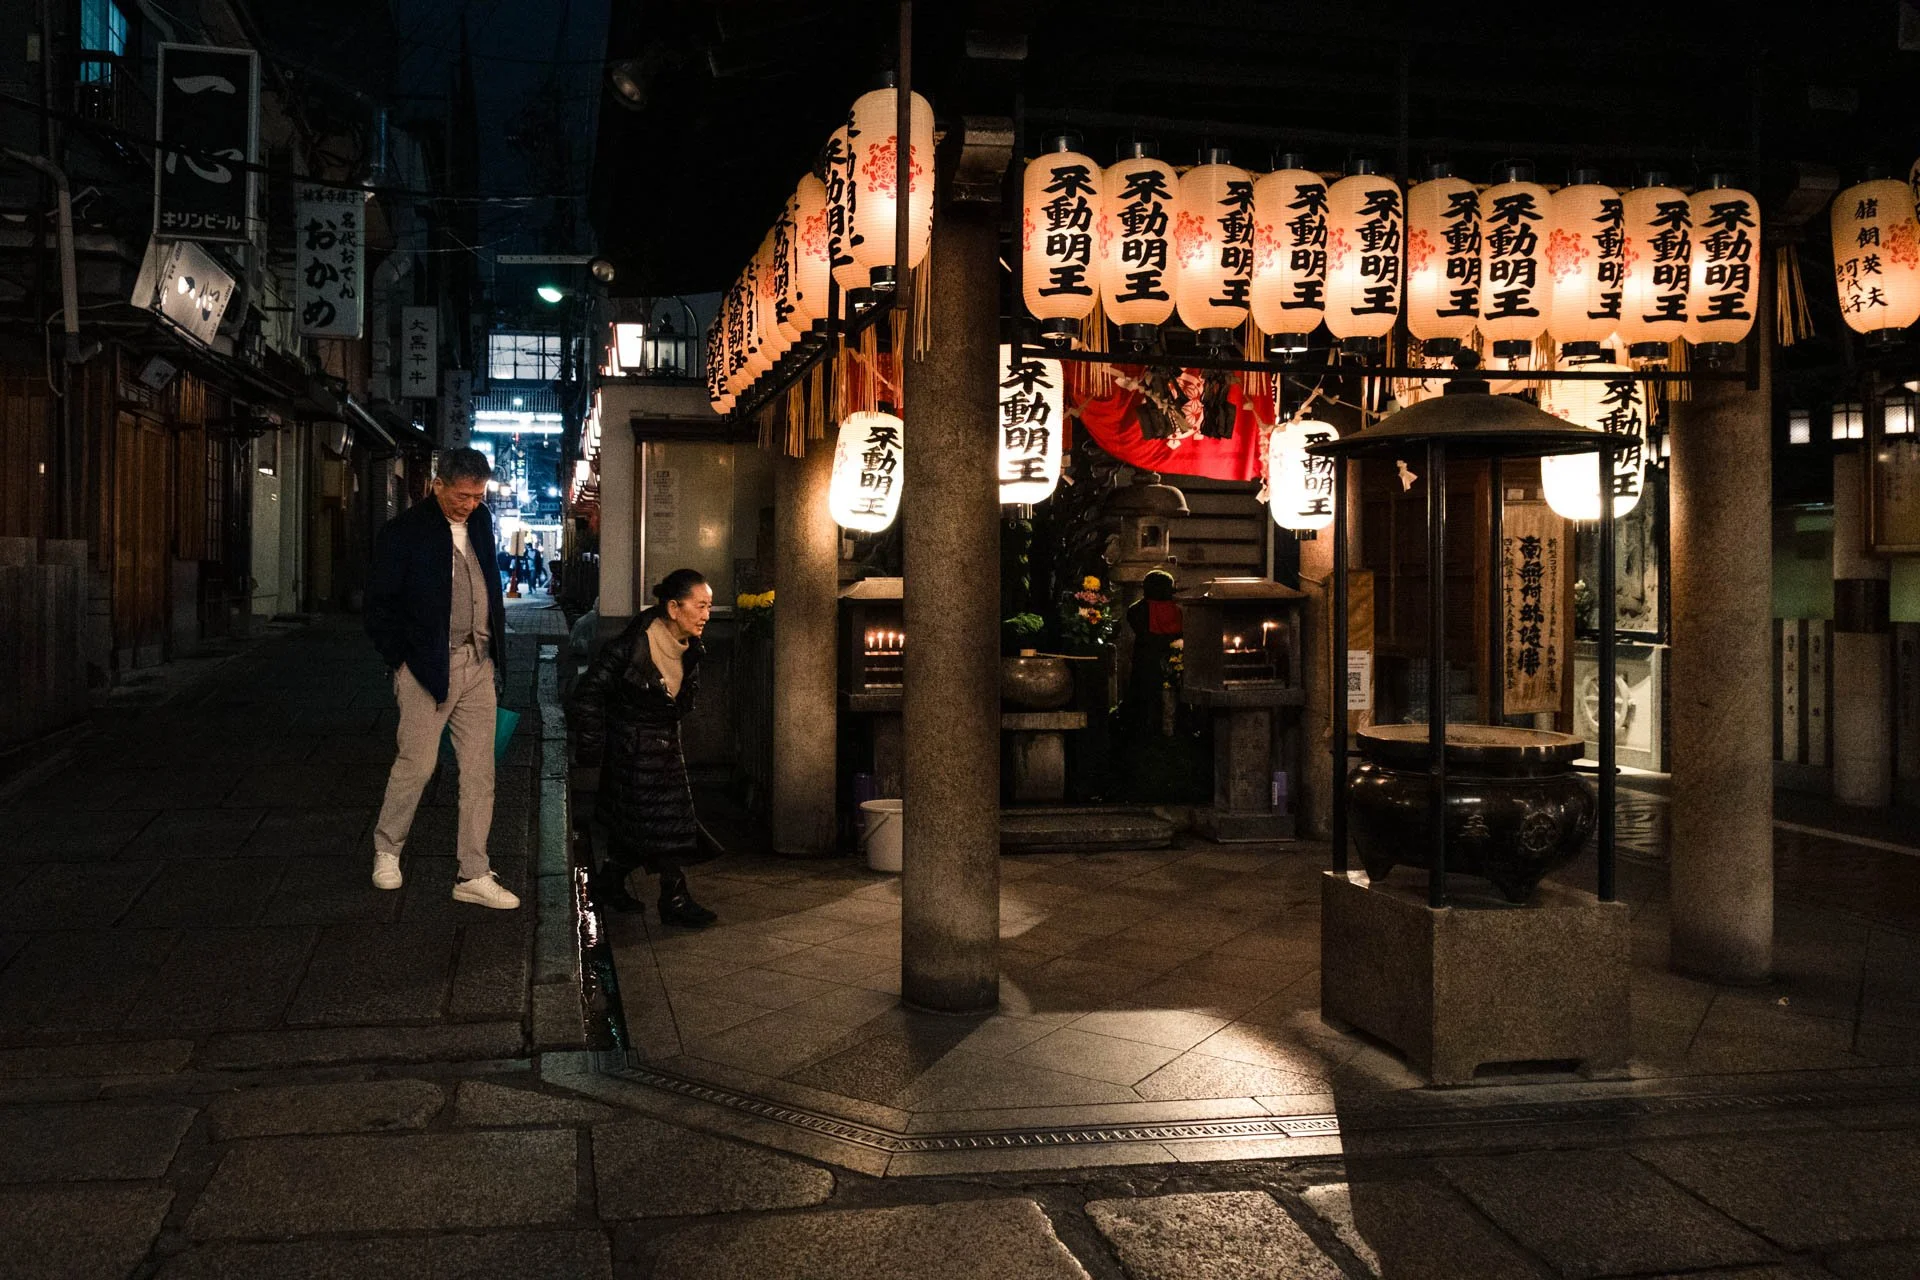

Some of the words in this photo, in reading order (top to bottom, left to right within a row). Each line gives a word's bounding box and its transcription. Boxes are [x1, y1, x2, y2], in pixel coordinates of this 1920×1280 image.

[162, 211, 241, 231] キリンビール
[303, 217, 339, 328] おかめ
[338, 211, 357, 299] 名代おでん
[1038, 165, 1097, 297] 不動明王
[1115, 170, 1173, 303] 不動明王
[1208, 181, 1255, 309] 不動明王
[1280, 184, 1329, 311] 不動明王
[1350, 190, 1402, 315] 不動明王
[1436, 191, 1482, 318] 不動明王
[1484, 193, 1544, 320] 不動明王
[1587, 199, 1625, 320] 不動明王
[1642, 200, 1693, 323] 不動明王
[1696, 200, 1756, 323] 不動明王
[850, 426, 902, 517] 不動明王
[1000, 360, 1054, 485] 不動明王
